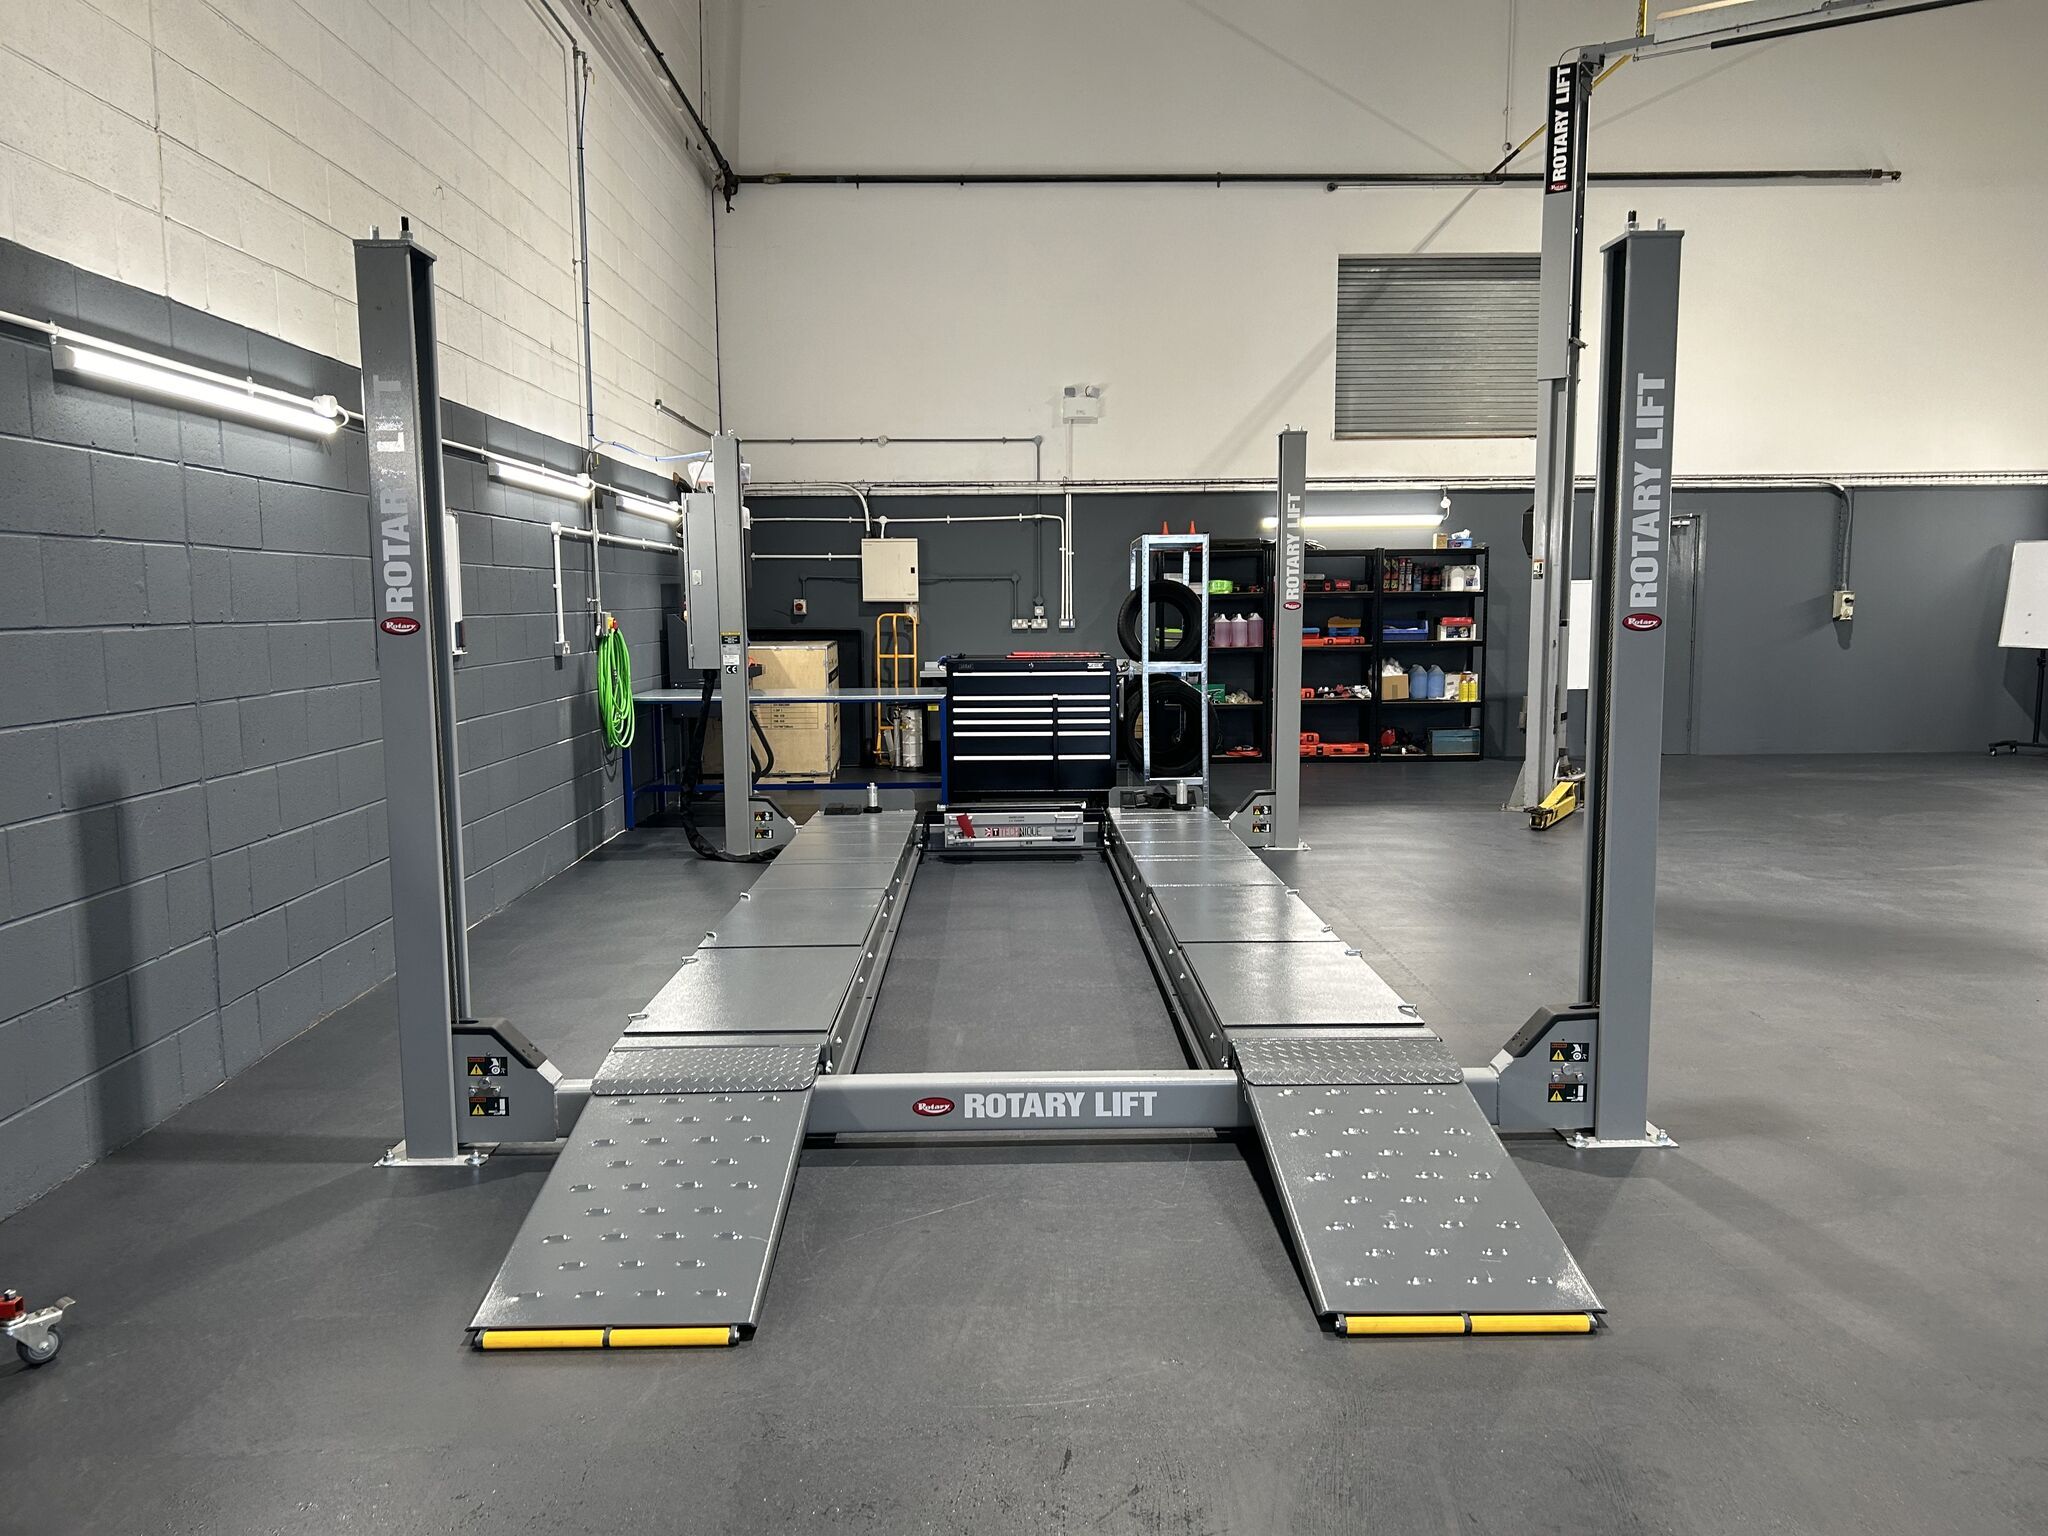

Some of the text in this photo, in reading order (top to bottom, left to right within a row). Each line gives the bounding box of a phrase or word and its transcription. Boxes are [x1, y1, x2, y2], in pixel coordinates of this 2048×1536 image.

[1552, 67, 1571, 182] ROTARY LIFT
[1630, 373, 1665, 607] ROTARY LIFT
[379, 466, 414, 612] ROTAR
[1286, 493, 1301, 600] ROTARY LIFT
[384, 620, 417, 632] Rotary
[1626, 615, 1659, 630] Rotary
[726, 665, 737, 673] CE
[917, 1091, 1157, 1118] Rotary ROTARY LIFT
